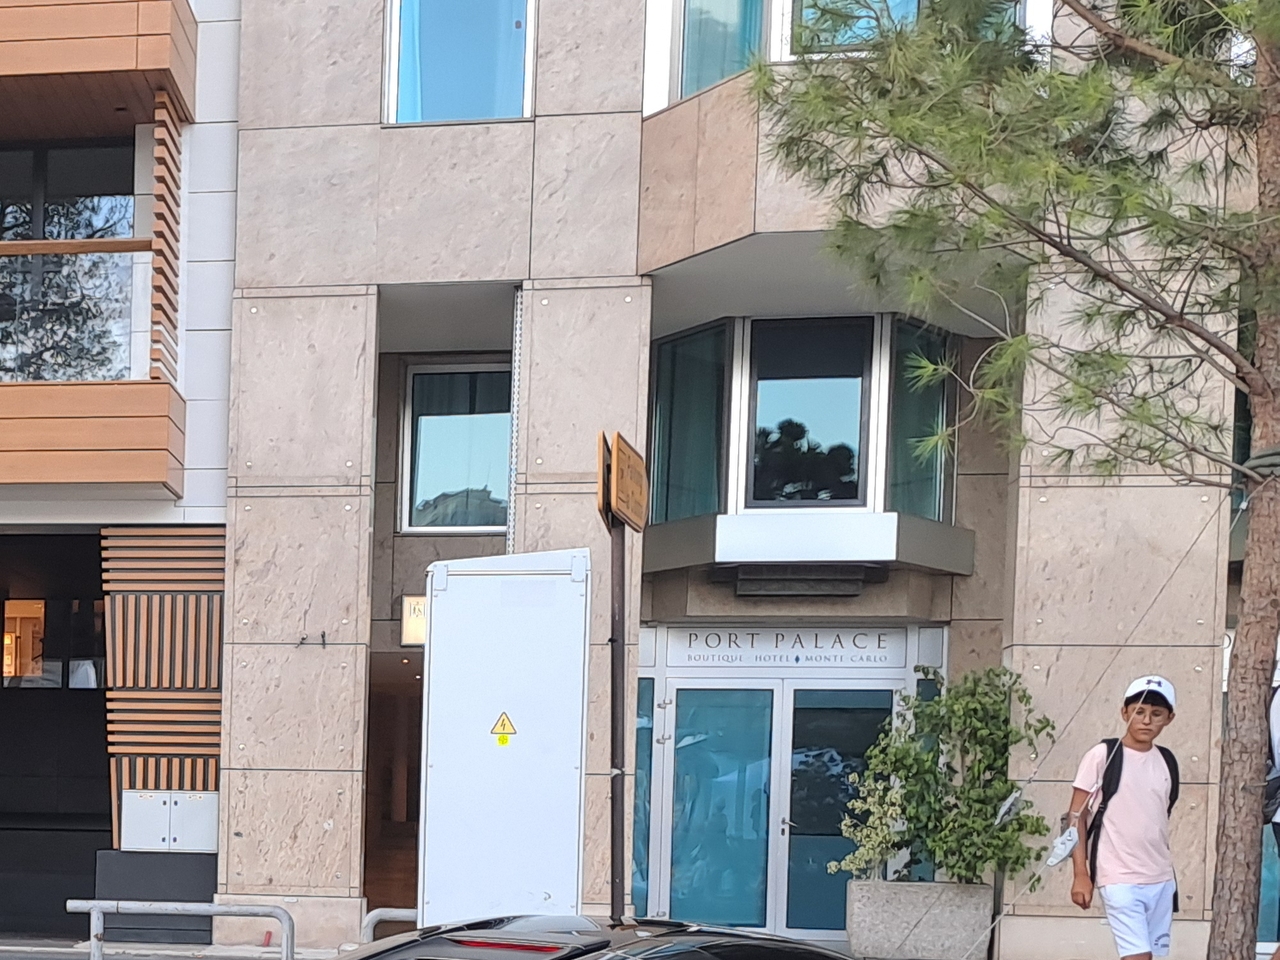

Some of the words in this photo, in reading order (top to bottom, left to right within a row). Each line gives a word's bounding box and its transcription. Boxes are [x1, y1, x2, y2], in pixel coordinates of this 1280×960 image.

[687, 632, 761, 650] PORT
[774, 632, 888, 650] PALACE
[687, 654, 743, 663] BOUTIQUE
[755, 654, 790, 663] HOTEL
[805, 654, 844, 663] MONTE
[850, 654, 888, 663] CARLO
